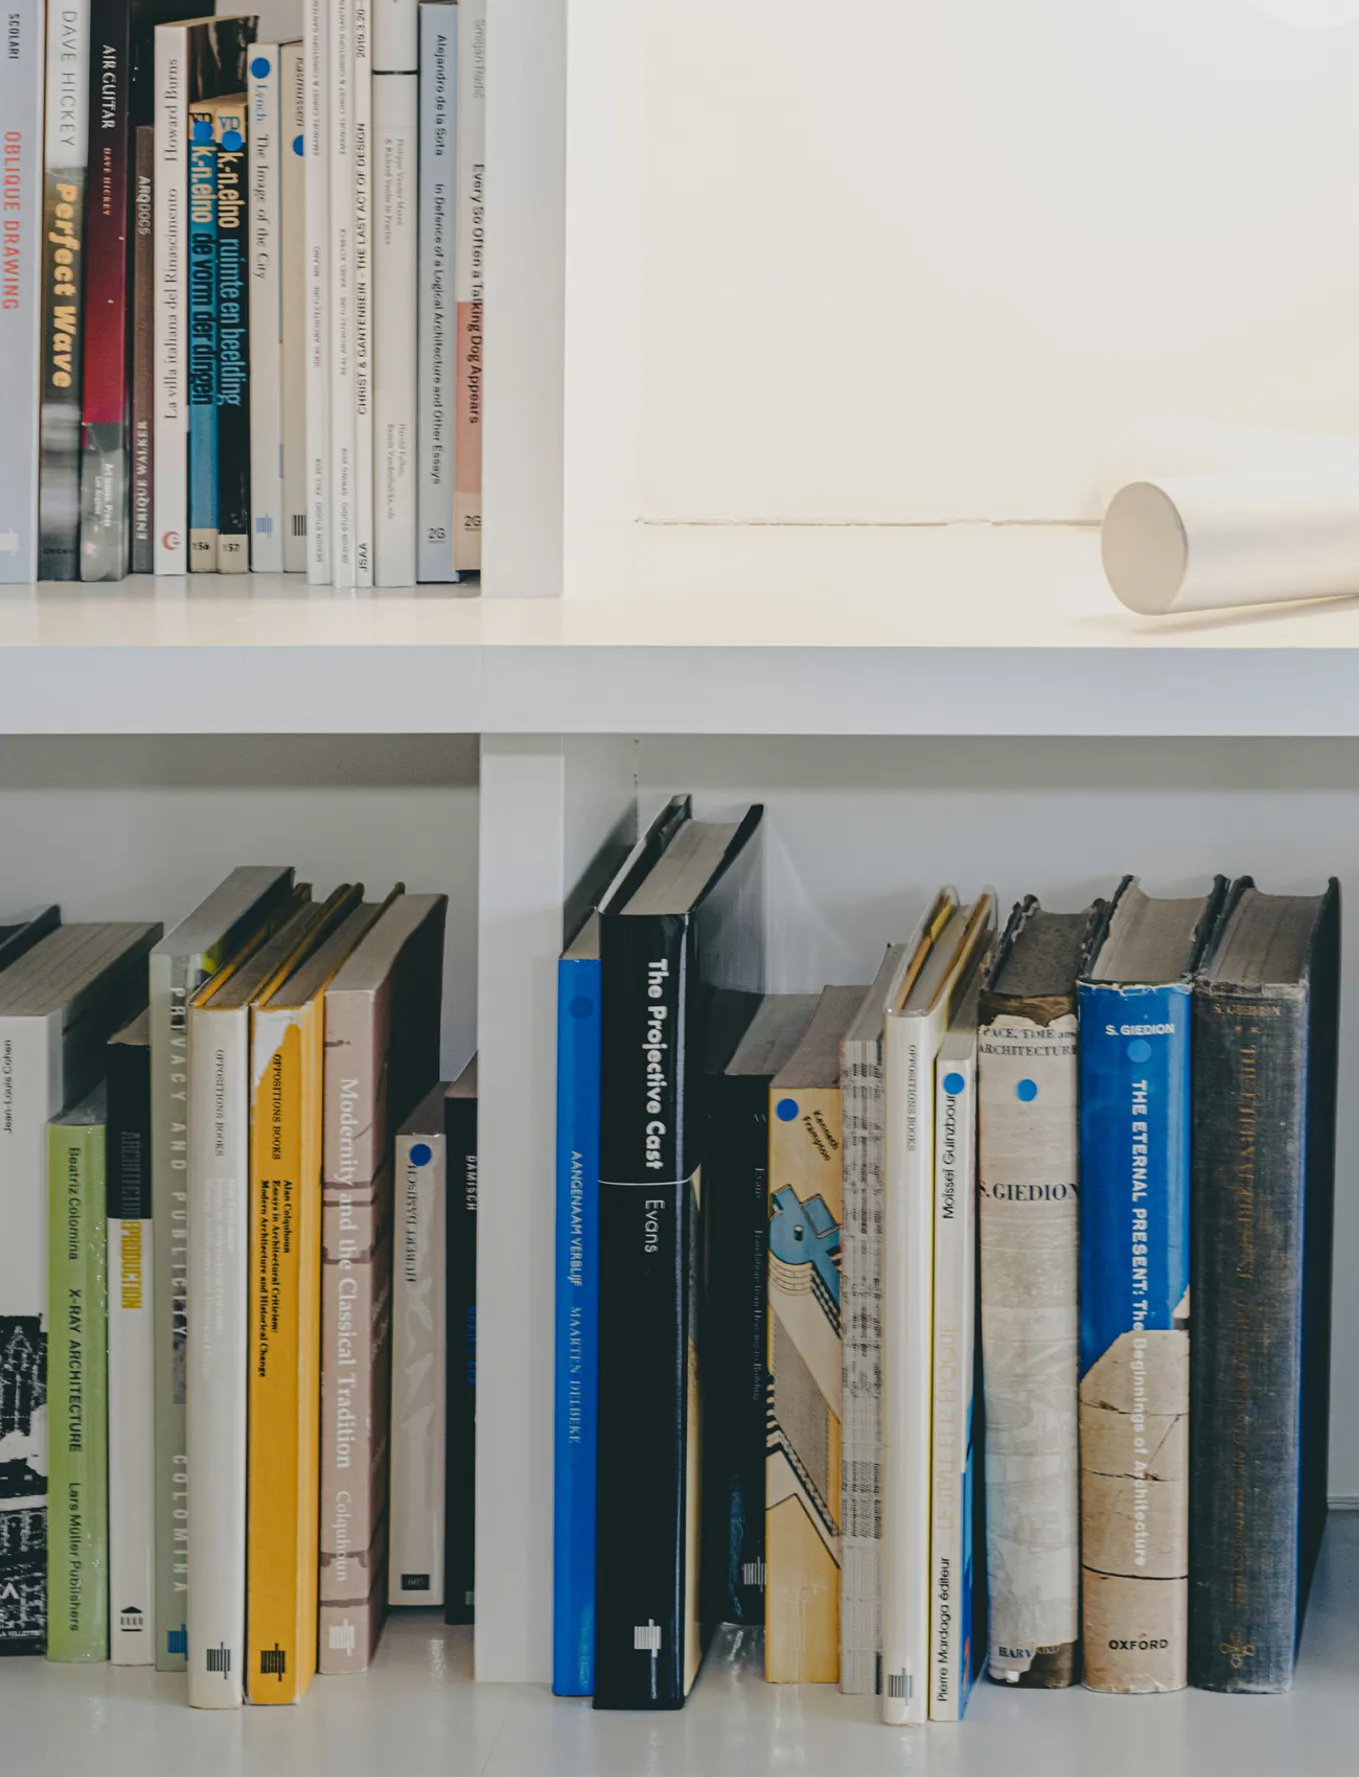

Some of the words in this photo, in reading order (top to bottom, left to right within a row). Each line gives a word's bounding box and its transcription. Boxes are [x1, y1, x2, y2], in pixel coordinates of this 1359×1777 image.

[102, 44, 116, 69] AIR
[102, 74, 116, 128] GUITAR
[256, 134, 269, 160] The
[3, 131, 21, 213] OBLIQUE
[252, 166, 269, 206] Image
[48, 183, 80, 296] Perfect
[256, 210, 270, 224] of
[256, 227, 269, 248] the
[3, 220, 20, 309] DRAWING
[220, 238, 242, 296] ruimte
[252, 253, 269, 279] City
[220, 302, 238, 322] en
[466, 283, 483, 331] Talking
[52, 305, 77, 388] Wave
[218, 328, 244, 406] beelding
[467, 335, 483, 362] Dog
[466, 366, 482, 424] Appears
[646, 959, 668, 999] The
[1105, 1024, 1119, 1035] S.
[1120, 1023, 1175, 1035] GIEDION
[642, 1006, 668, 1114] Projective
[1130, 1078, 1147, 1115] THE
[335, 1078, 359, 1186] Modernity
[645, 1121, 666, 1170] Cast
[1130, 1119, 1148, 1203] ETERNAL
[339, 1193, 358, 1230] and
[644, 1199, 665, 1253] Evans
[338, 1238, 357, 1269] the
[1130, 1208, 1148, 1296] PRESENT:
[68, 1288, 82, 1333] X-RAY
[337, 1277, 358, 1363] Classical
[68, 1340, 82, 1452] ARCHITECTURE
[335, 1372, 356, 1469] Tradition
[68, 1482, 81, 1511] Lars
[68, 1514, 82, 1557] Müller
[68, 1561, 82, 1632] Publishers
[1108, 1638, 1168, 1652] OXFORD
